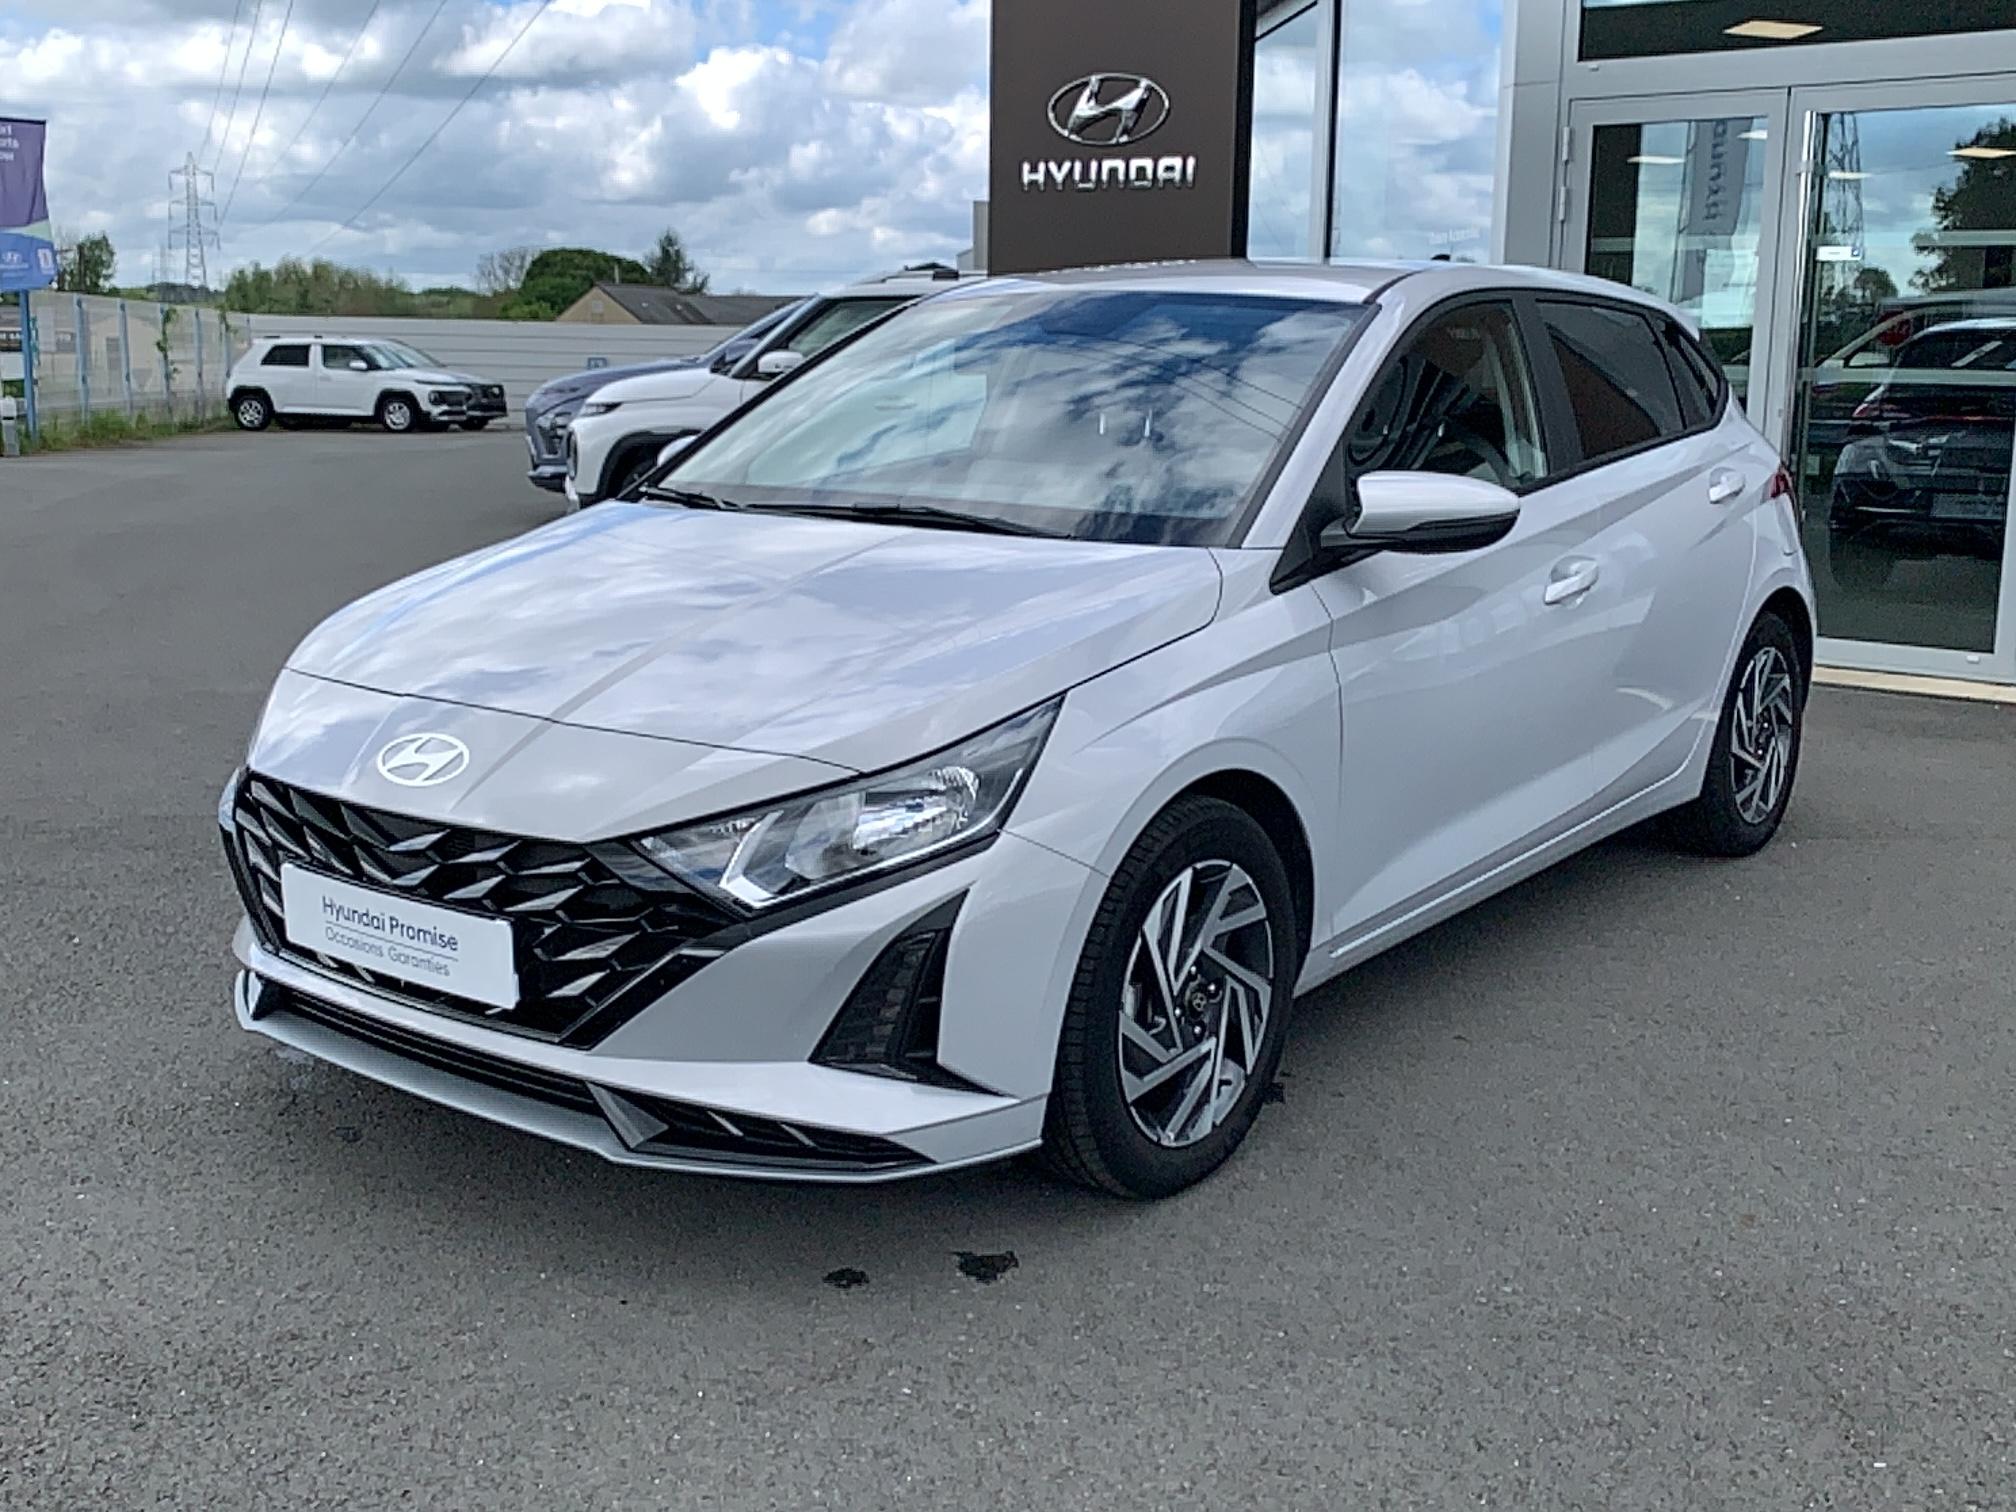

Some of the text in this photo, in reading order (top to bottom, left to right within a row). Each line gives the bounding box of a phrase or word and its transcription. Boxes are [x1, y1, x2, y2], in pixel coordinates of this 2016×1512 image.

[1022, 156, 1196, 191] HYUNDAI
[322, 895, 458, 951] Hyundai Promise
[325, 926, 450, 976] Occasions Garanties
